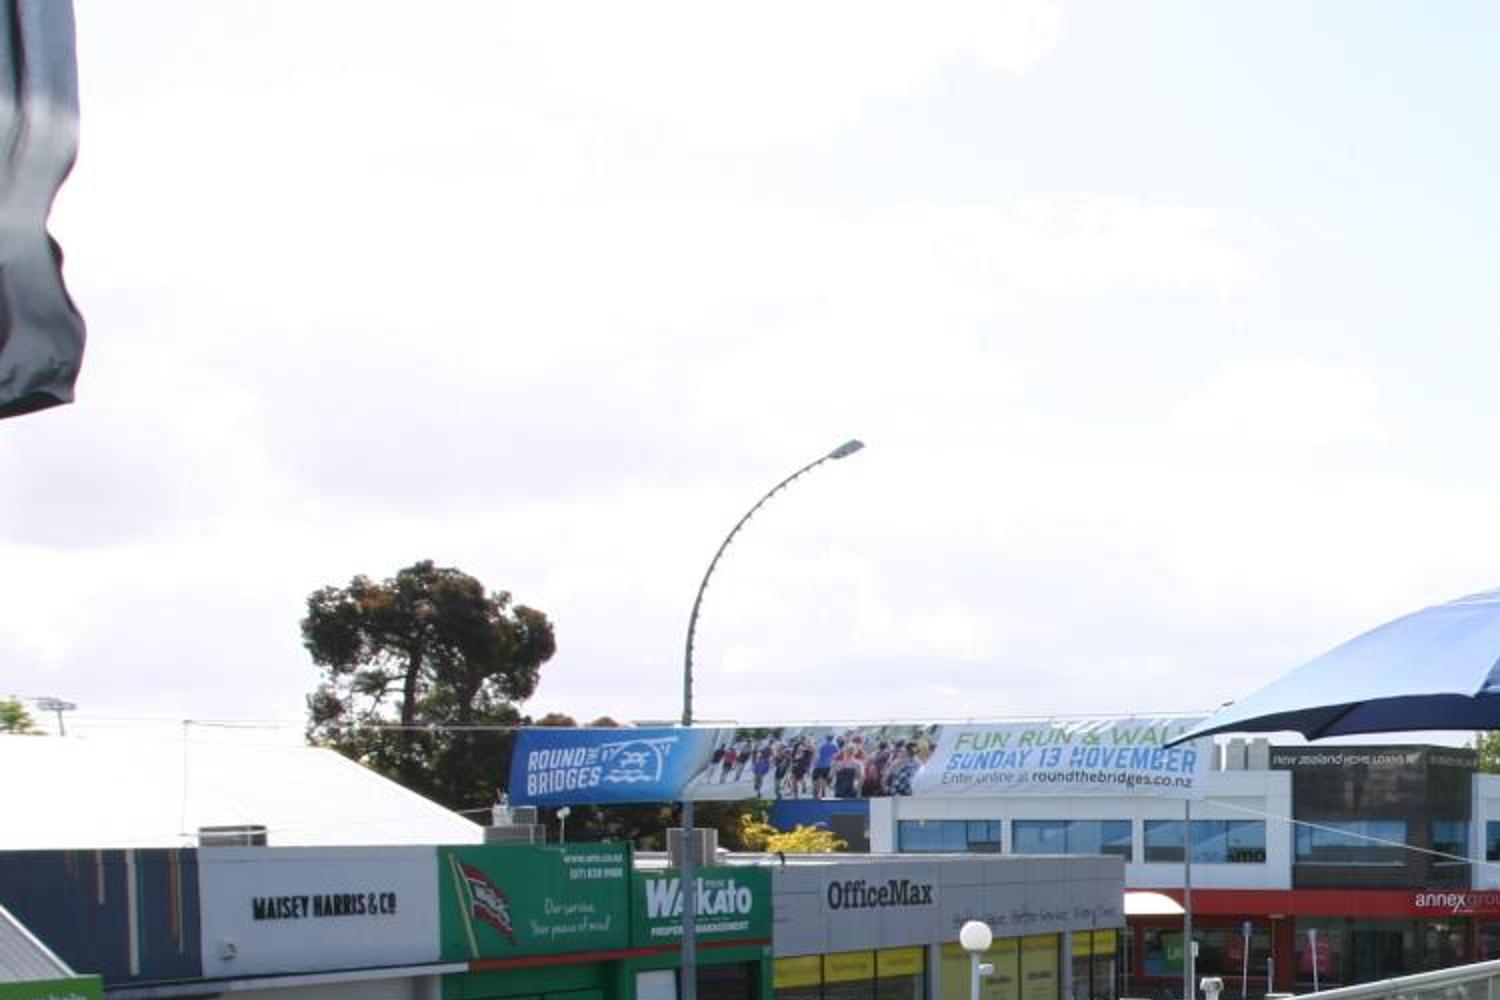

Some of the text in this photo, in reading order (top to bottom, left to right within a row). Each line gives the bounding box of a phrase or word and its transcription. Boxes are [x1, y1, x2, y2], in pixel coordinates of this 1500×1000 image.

[955, 731, 1010, 751] FUN
[1018, 728, 1072, 748] RUN
[1081, 729, 1101, 746] &
[528, 747, 586, 771] ROUND
[946, 746, 1197, 774] SUNDAY 13 NOVEMBER
[1298, 752, 1343, 766] zealand
[527, 767, 602, 797] BRIDGES
[941, 771, 975, 784] Enter
[976, 771, 1014, 785] online
[1031, 770, 1193, 788] roundthebridges.co.nz
[252, 895, 309, 921] MAISEY
[313, 893, 366, 917] HARRIS
[367, 892, 378, 915] &
[827, 879, 933, 910] OfficeMax
